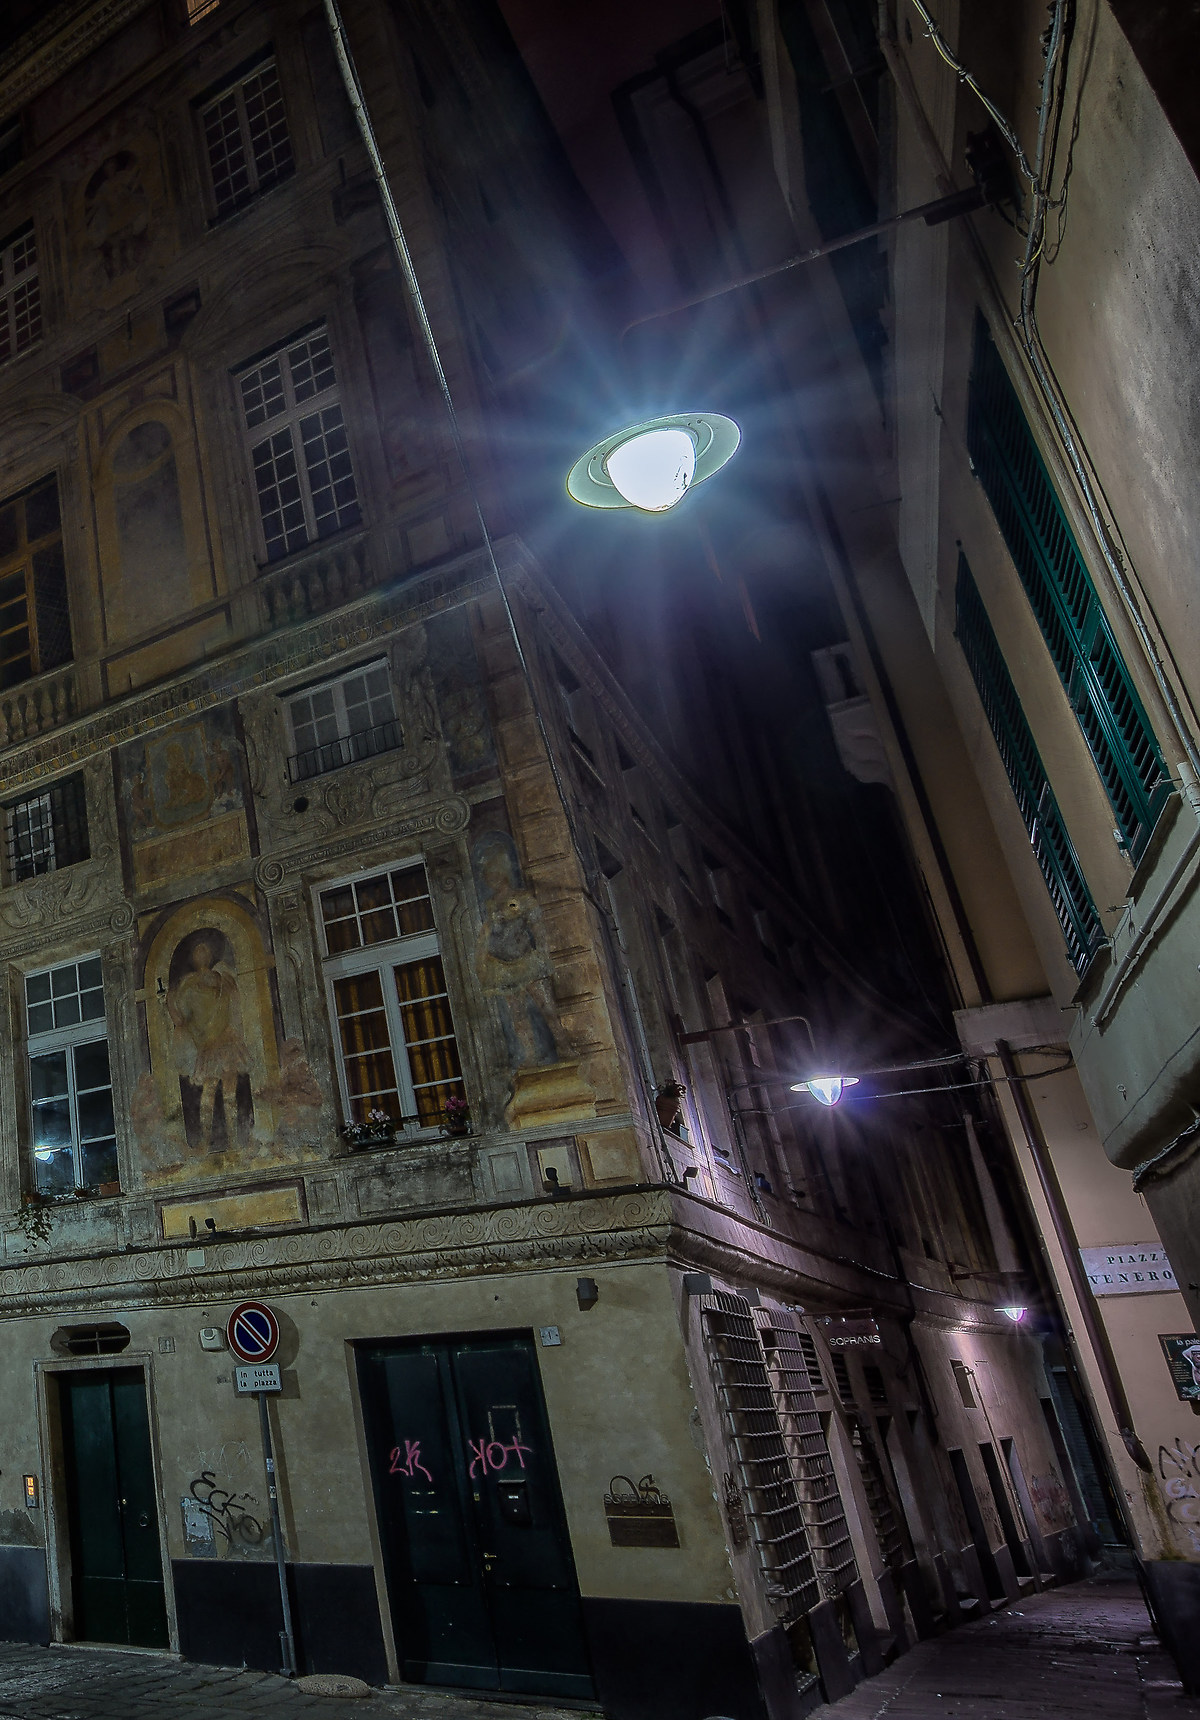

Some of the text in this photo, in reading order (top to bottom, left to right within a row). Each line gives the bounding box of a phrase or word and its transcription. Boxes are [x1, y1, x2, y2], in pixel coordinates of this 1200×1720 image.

[1088, 1270, 1172, 1285] VENERO
[829, 1334, 881, 1346] SOPRANIS
[254, 1380, 277, 1388] piazza
